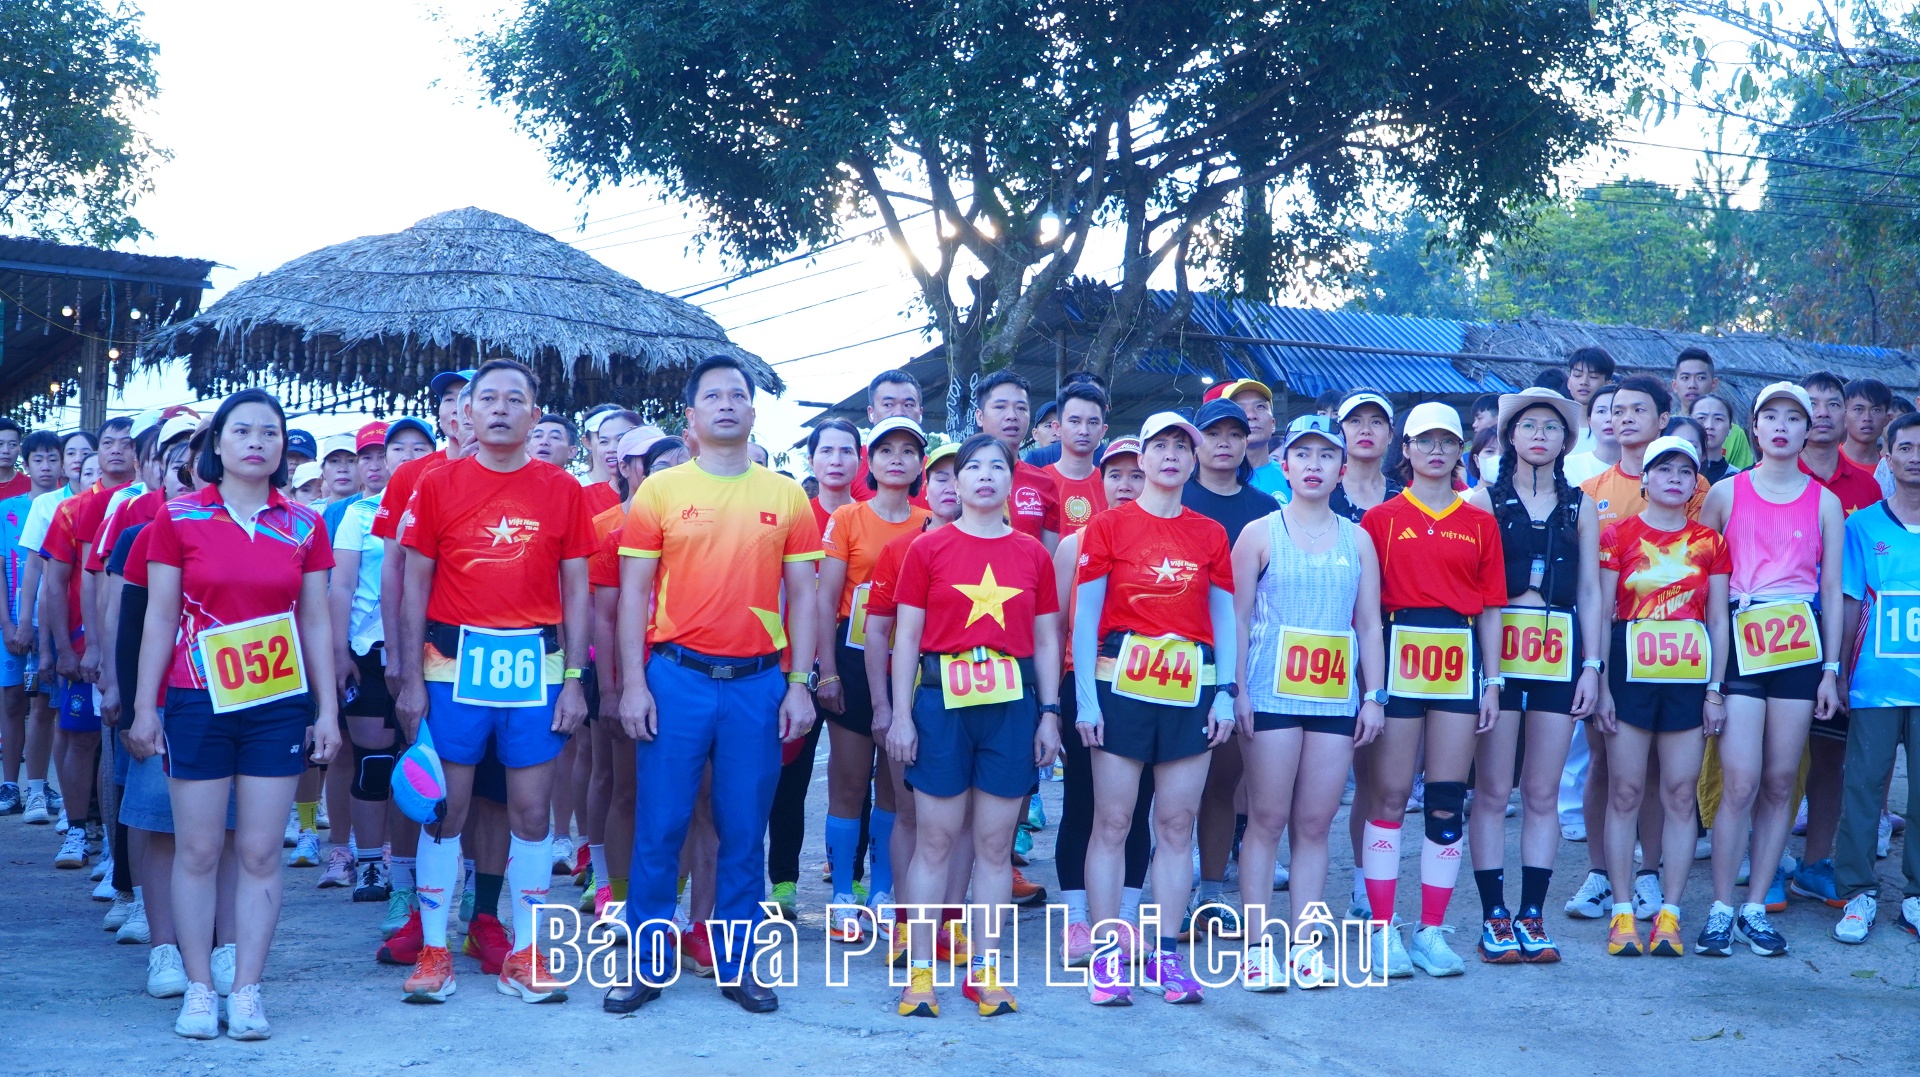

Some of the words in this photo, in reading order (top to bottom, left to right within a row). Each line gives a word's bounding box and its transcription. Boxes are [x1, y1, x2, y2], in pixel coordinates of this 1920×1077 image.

[1440, 530, 1458, 540] VIỆT
[1458, 533, 1476, 545] NAM
[1666, 588, 1696, 616] NAM
[1500, 624, 1564, 664] 066
[1636, 630, 1702, 667] 054
[1743, 614, 1811, 658] 022
[215, 634, 295, 691] 052
[468, 646, 536, 690] 186
[947, 657, 1017, 697] 091
[1125, 644, 1193, 689] 044
[1285, 644, 1347, 686] 094
[1399, 643, 1464, 682] 009
